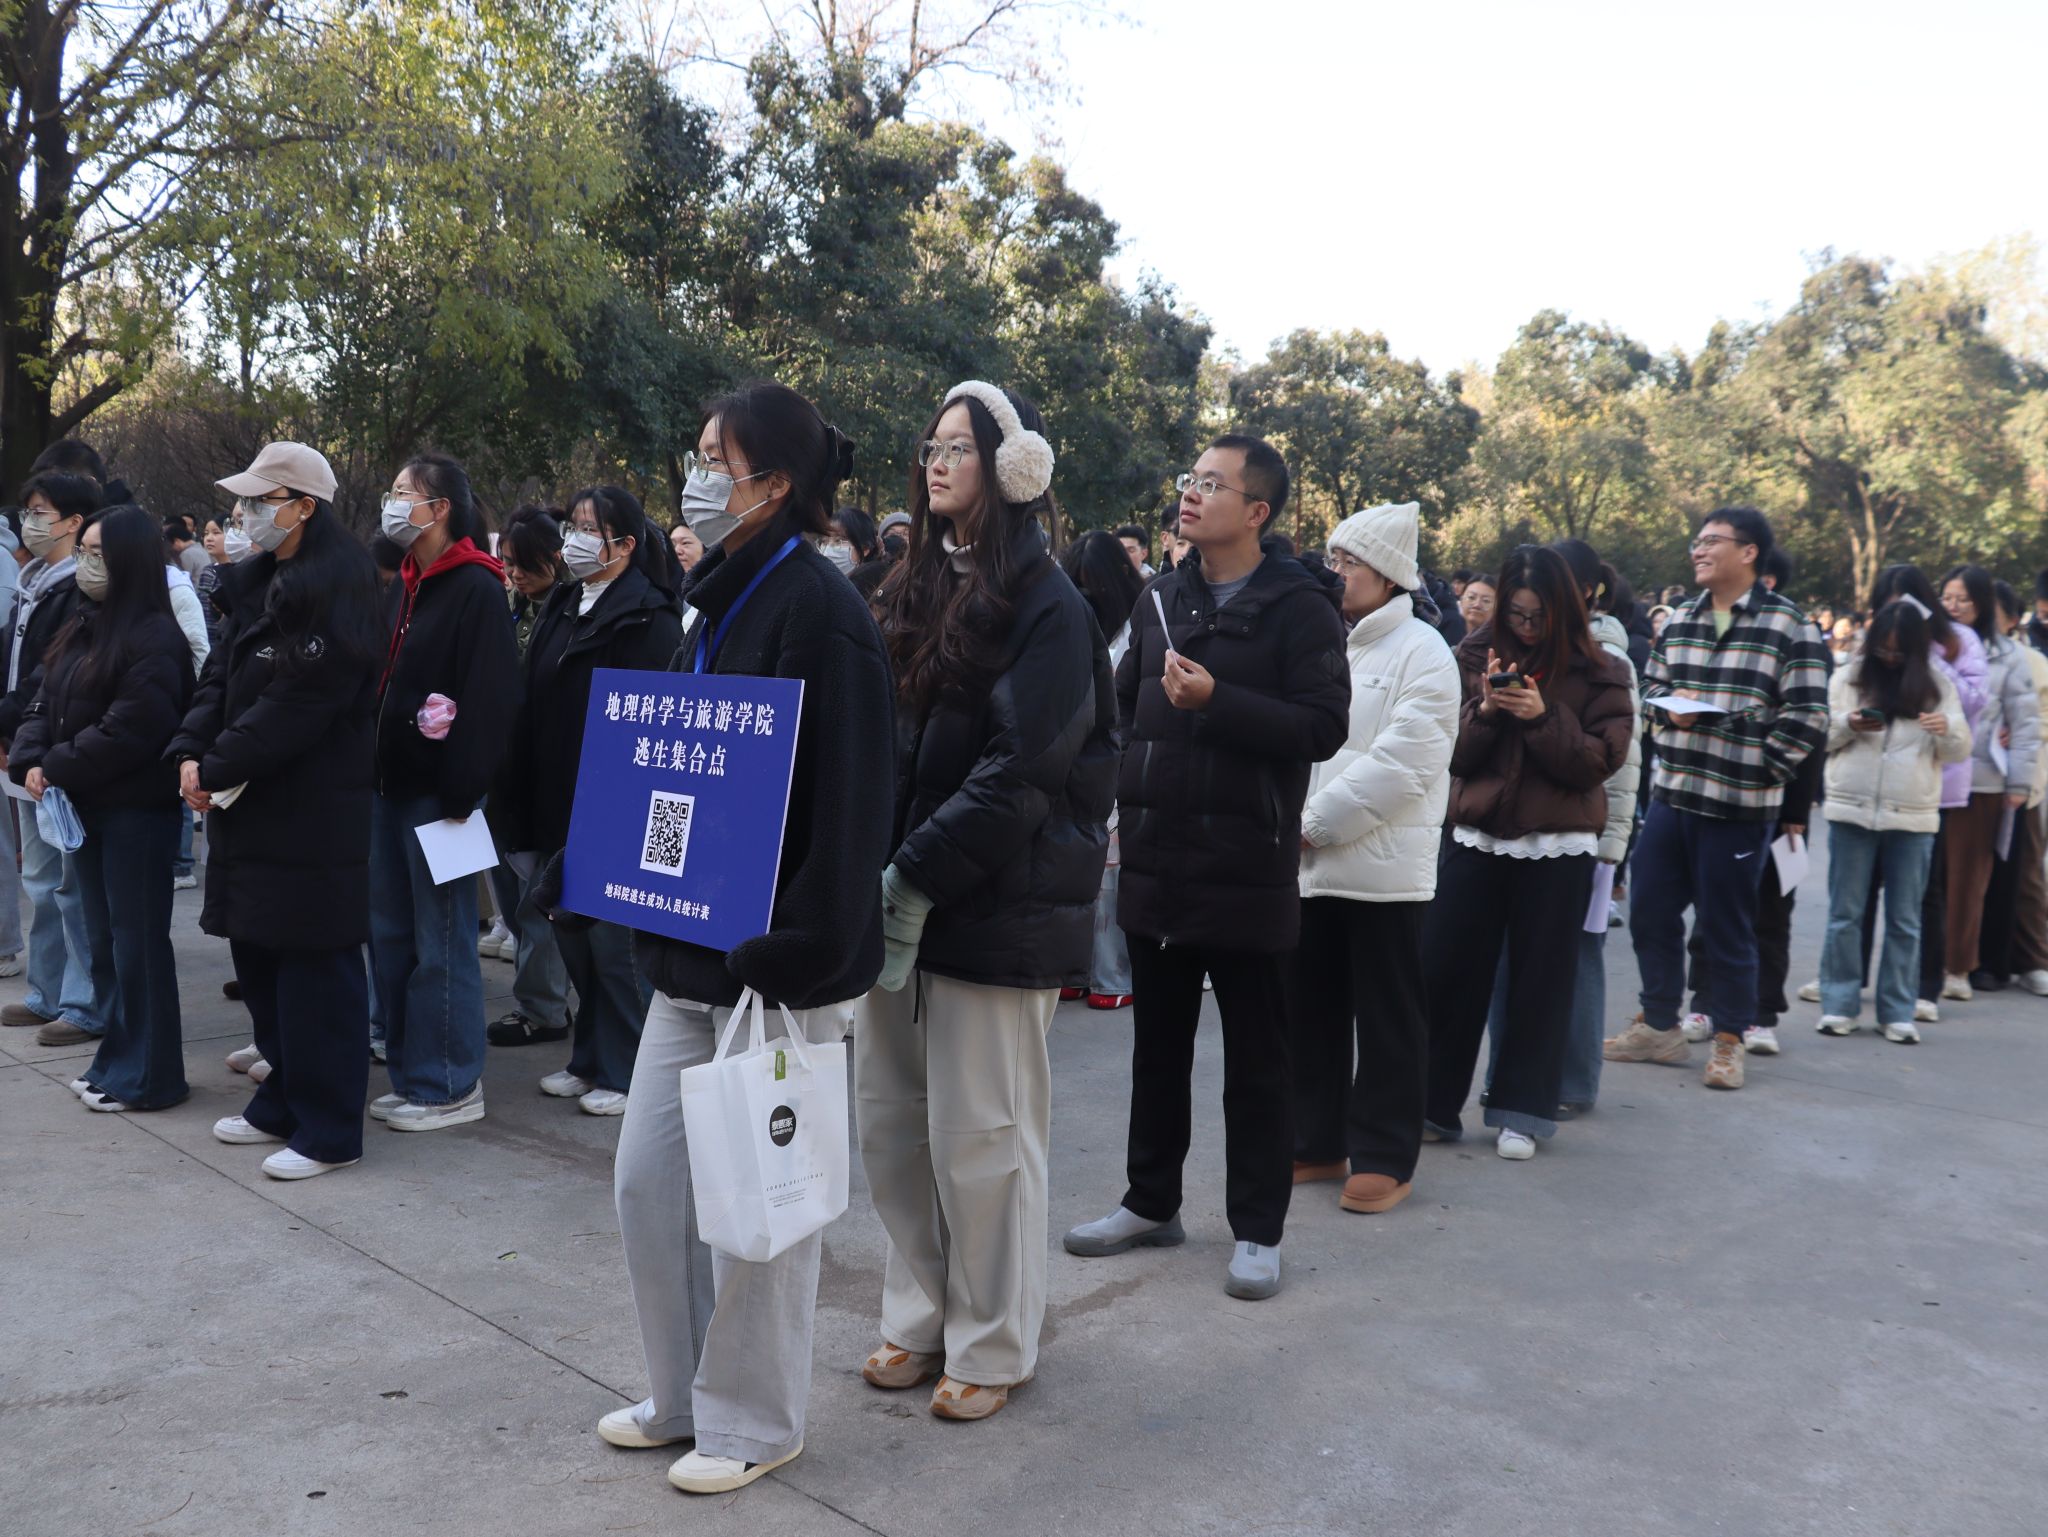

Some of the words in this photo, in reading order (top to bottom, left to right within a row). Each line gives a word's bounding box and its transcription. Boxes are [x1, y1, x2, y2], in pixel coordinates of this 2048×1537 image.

[605, 692, 775, 736] 地理科学与旅游学院
[632, 737, 727, 777] 逃生集合点
[604, 882, 710, 921] 地科院逃生成功人员统计表
